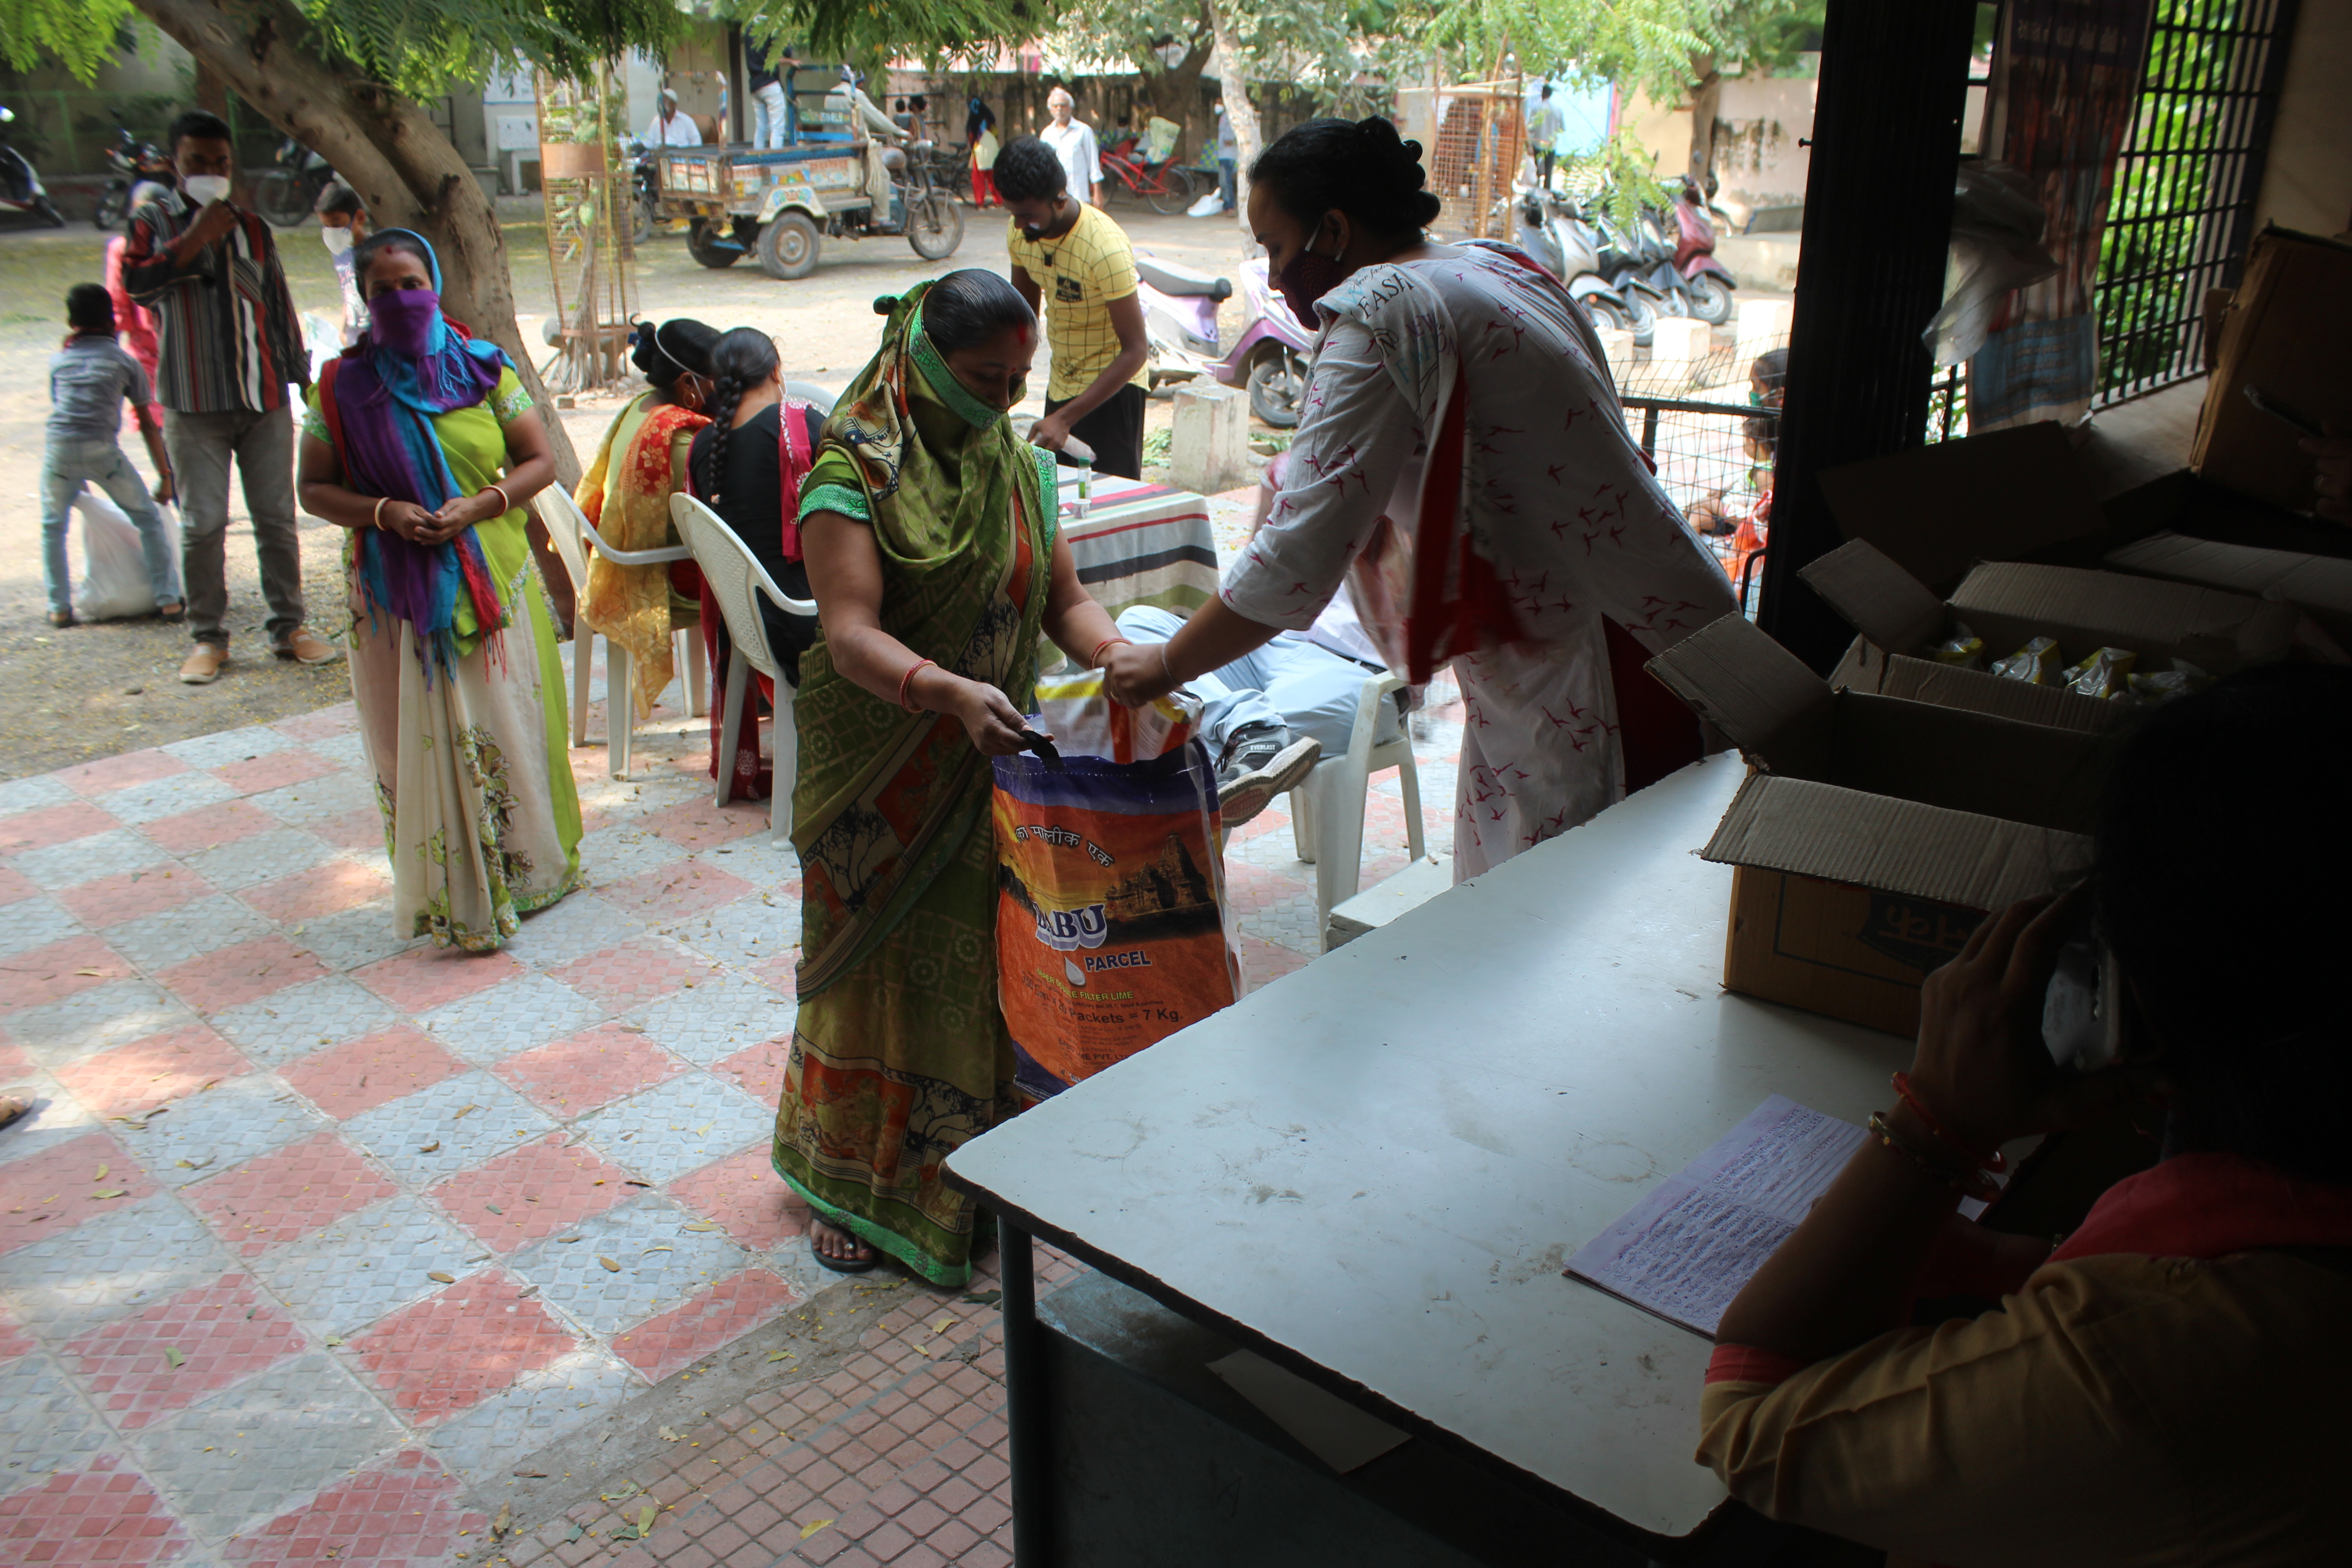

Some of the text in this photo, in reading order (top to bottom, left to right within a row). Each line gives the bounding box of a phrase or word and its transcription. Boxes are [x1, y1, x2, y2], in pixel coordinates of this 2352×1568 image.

[1030, 826, 1081, 846] मालीक
[1088, 842, 1114, 867] एक
[1084, 950, 1152, 972] PARCEL
[1036, 968, 1134, 1002] SUPER DOUBLE FILTER LIME
[1068, 1006, 1124, 1024] Packets
[1142, 1009, 1151, 1020] 7
[1156, 1008, 1183, 1023] Kg.
